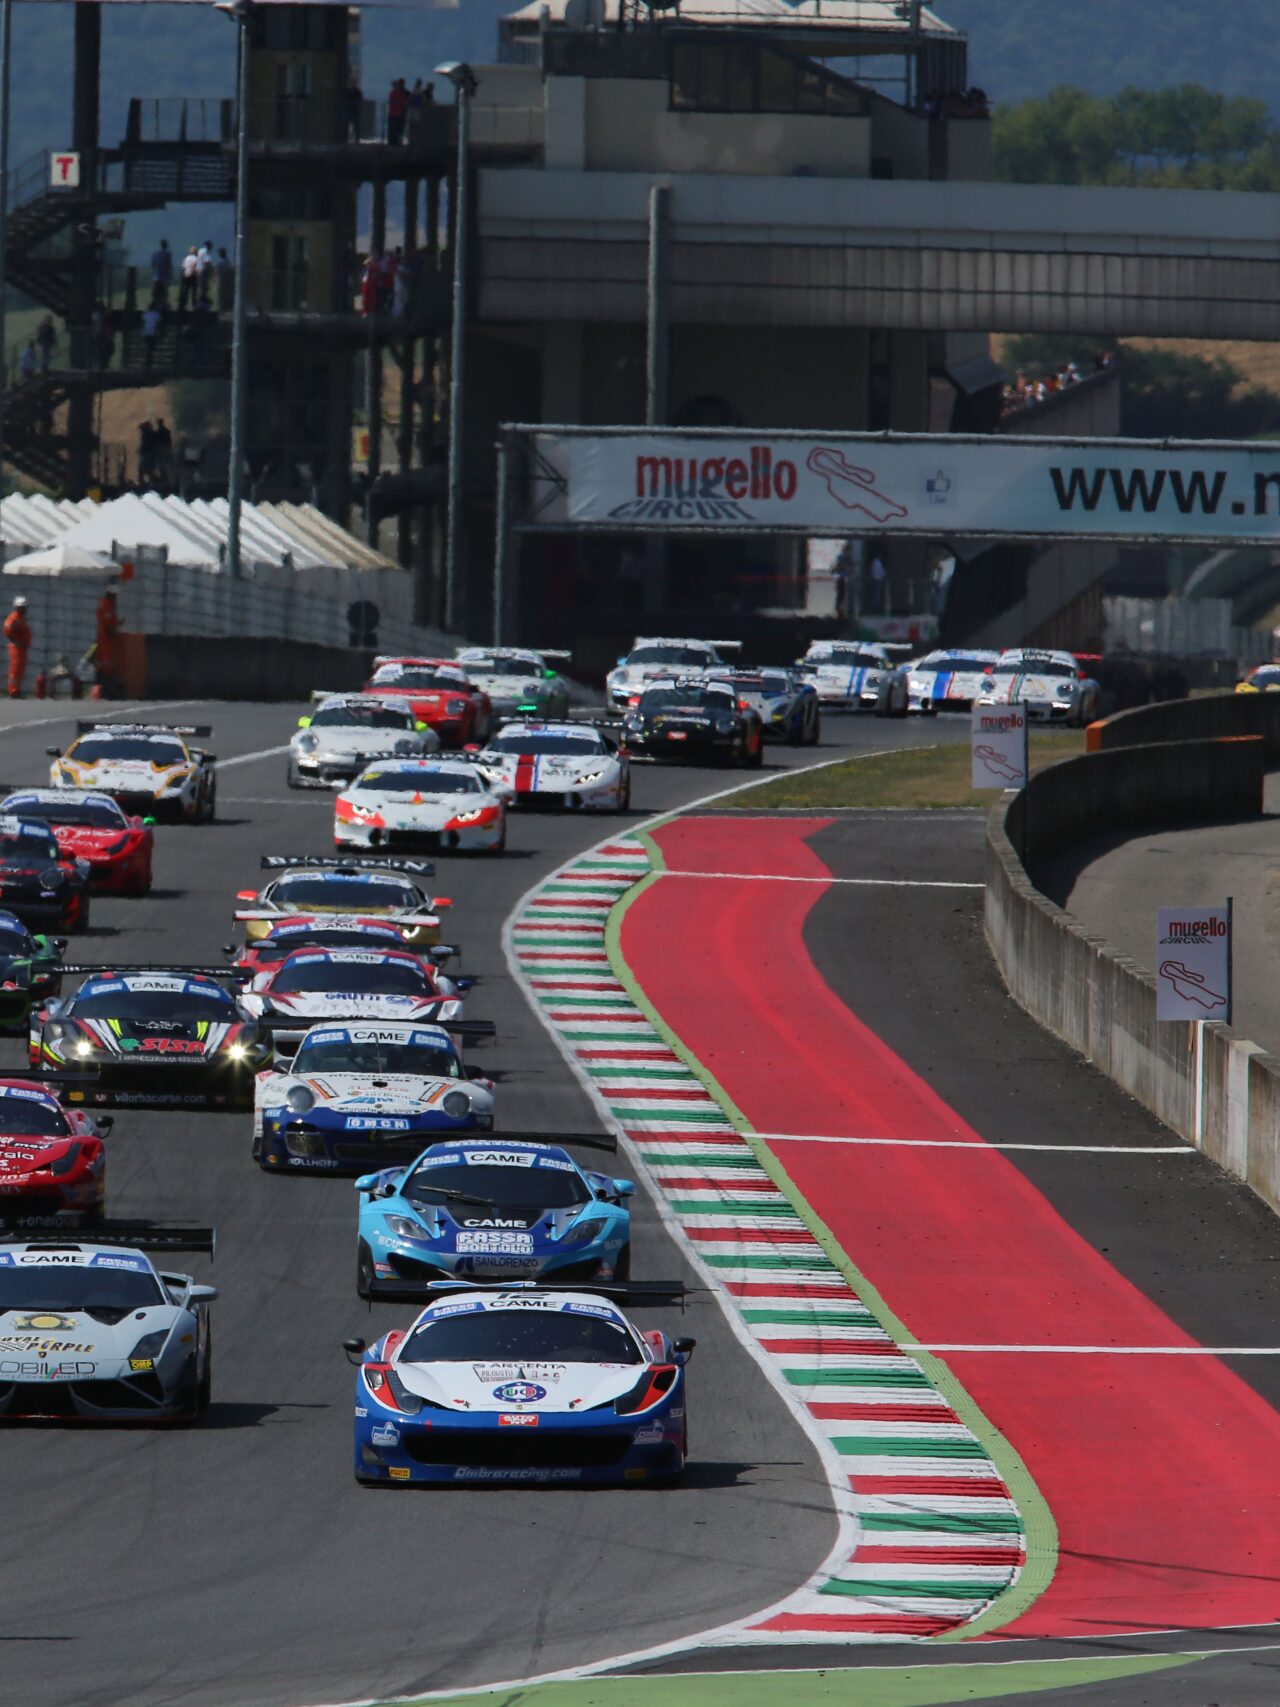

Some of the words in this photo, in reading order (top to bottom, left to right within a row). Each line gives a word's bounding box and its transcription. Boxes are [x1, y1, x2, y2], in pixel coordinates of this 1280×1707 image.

[56, 157, 74, 181] T
[635, 445, 798, 501] mugello
[607, 499, 757, 521] CIRCUIT
[980, 713, 1024, 729] mugello
[1169, 917, 1226, 937] mugello
[131, 981, 180, 990] CAME
[354, 1031, 405, 1041] CAME
[138, 1038, 207, 1054] SISA
[470, 1153, 529, 1164] CAME
[463, 1219, 528, 1229] CAME
[456, 1231, 533, 1245] FASSA
[456, 1243, 533, 1255] BORTOLO
[19, 1255, 85, 1264] CAME
[474, 1256, 539, 1268] SANLORENZO
[489, 1300, 557, 1308] CAME
[131, 1361, 153, 1369] OMP
